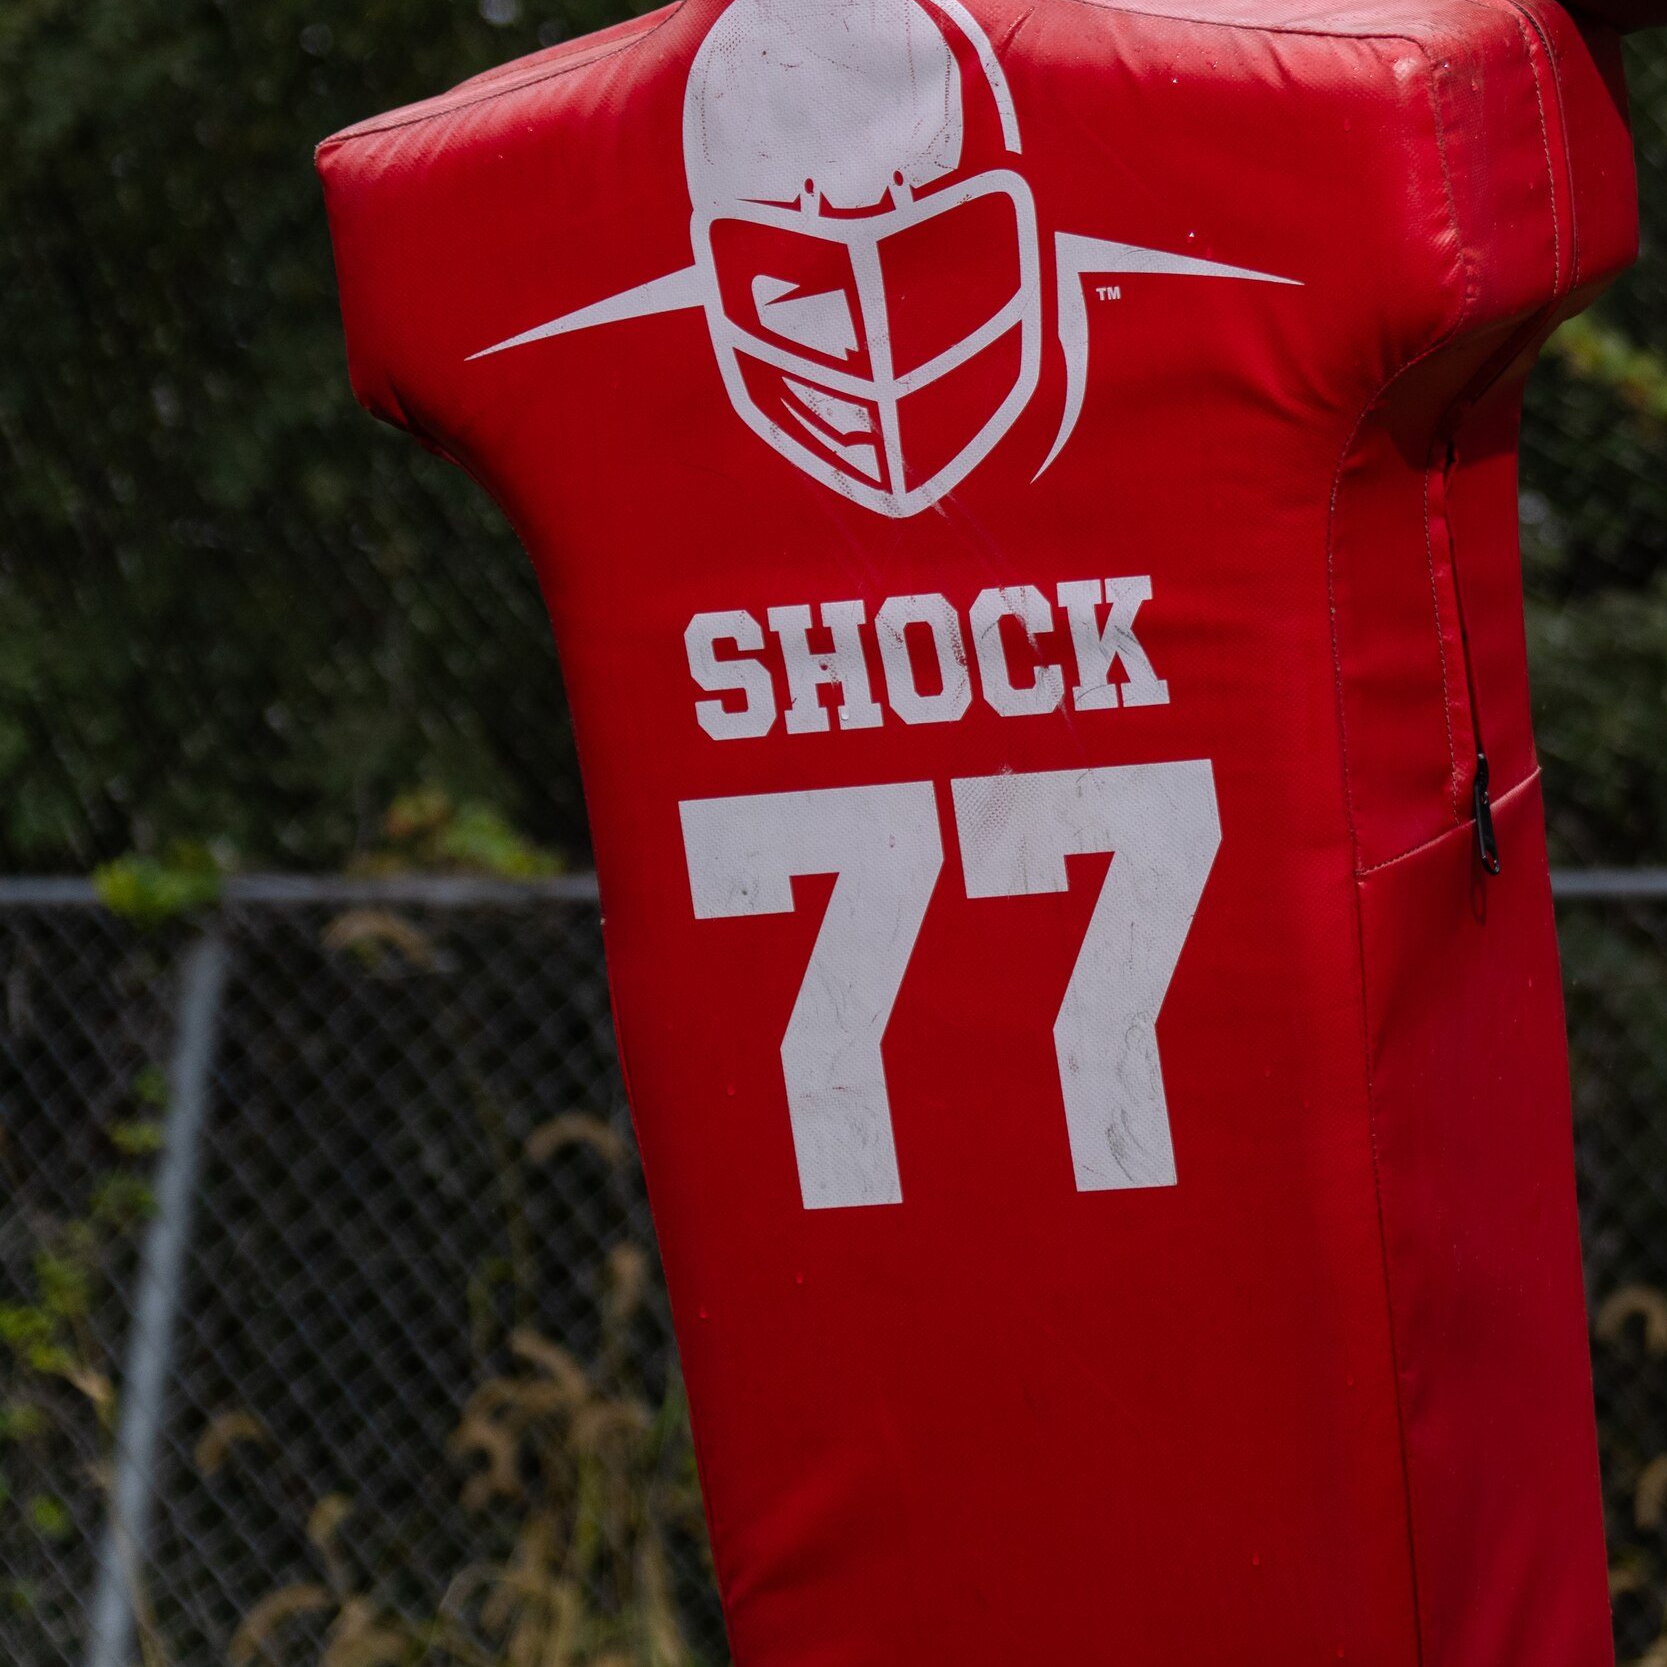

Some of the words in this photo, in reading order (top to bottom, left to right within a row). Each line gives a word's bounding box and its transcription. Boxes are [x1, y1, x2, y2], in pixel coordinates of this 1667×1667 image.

[1095, 286, 1121, 301] TM
[683, 574, 1171, 741] SHOCK
[678, 758, 1223, 1210] 77
